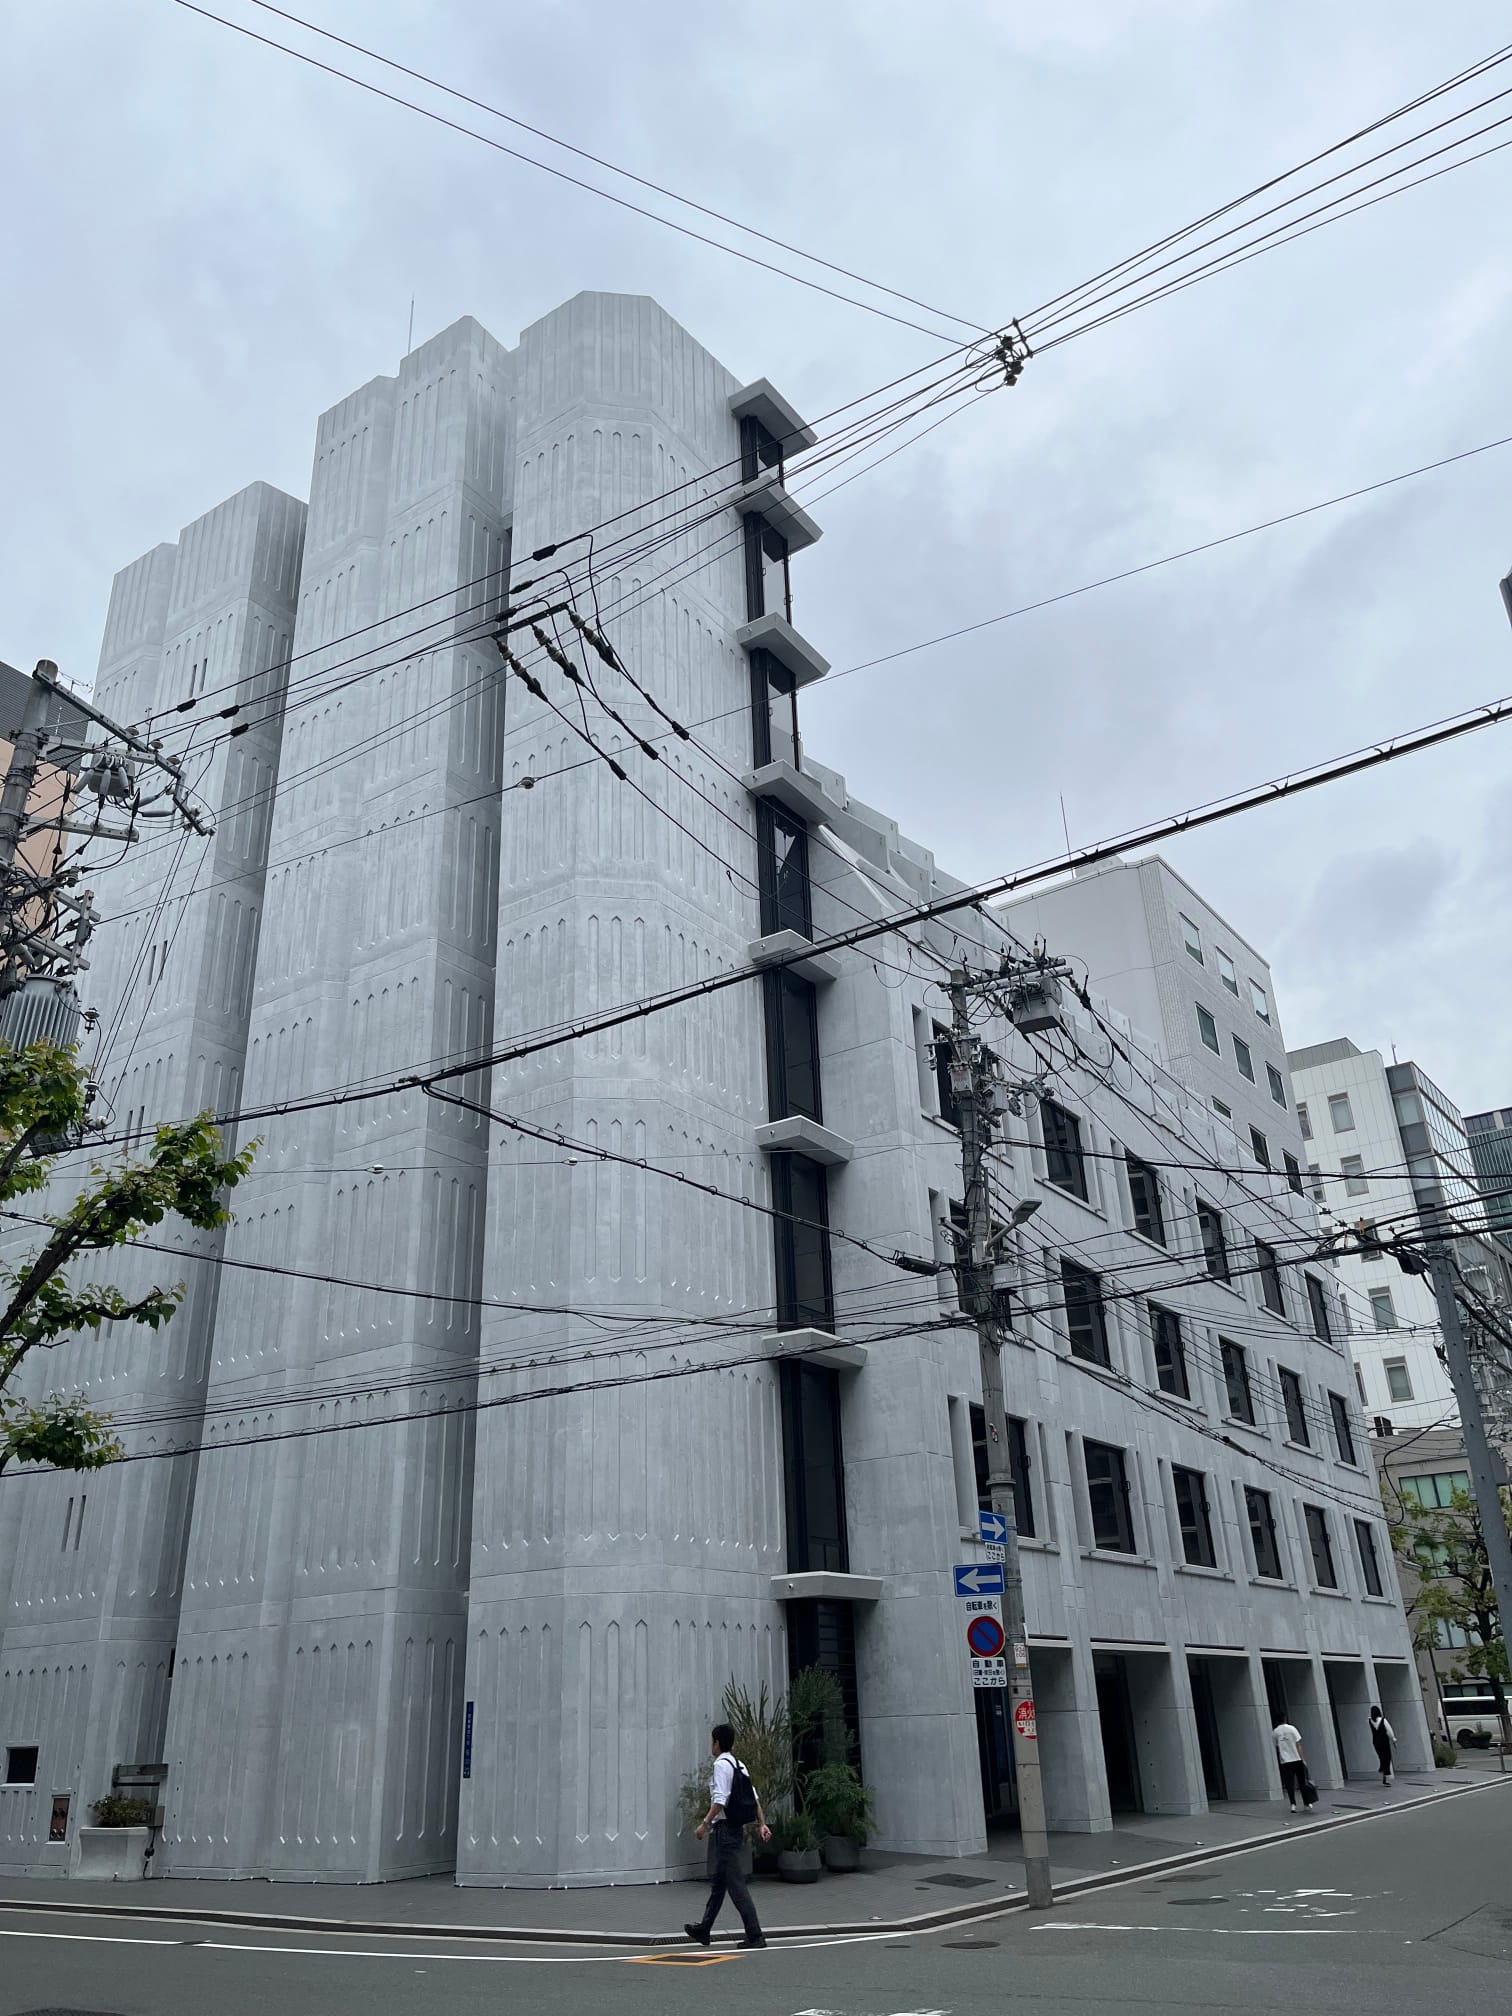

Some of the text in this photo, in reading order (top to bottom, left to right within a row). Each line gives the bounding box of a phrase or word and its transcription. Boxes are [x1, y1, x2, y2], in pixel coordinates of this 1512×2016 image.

[965, 1600, 998, 1611] 自転車を除く
[974, 1677, 1006, 1686] ここから
